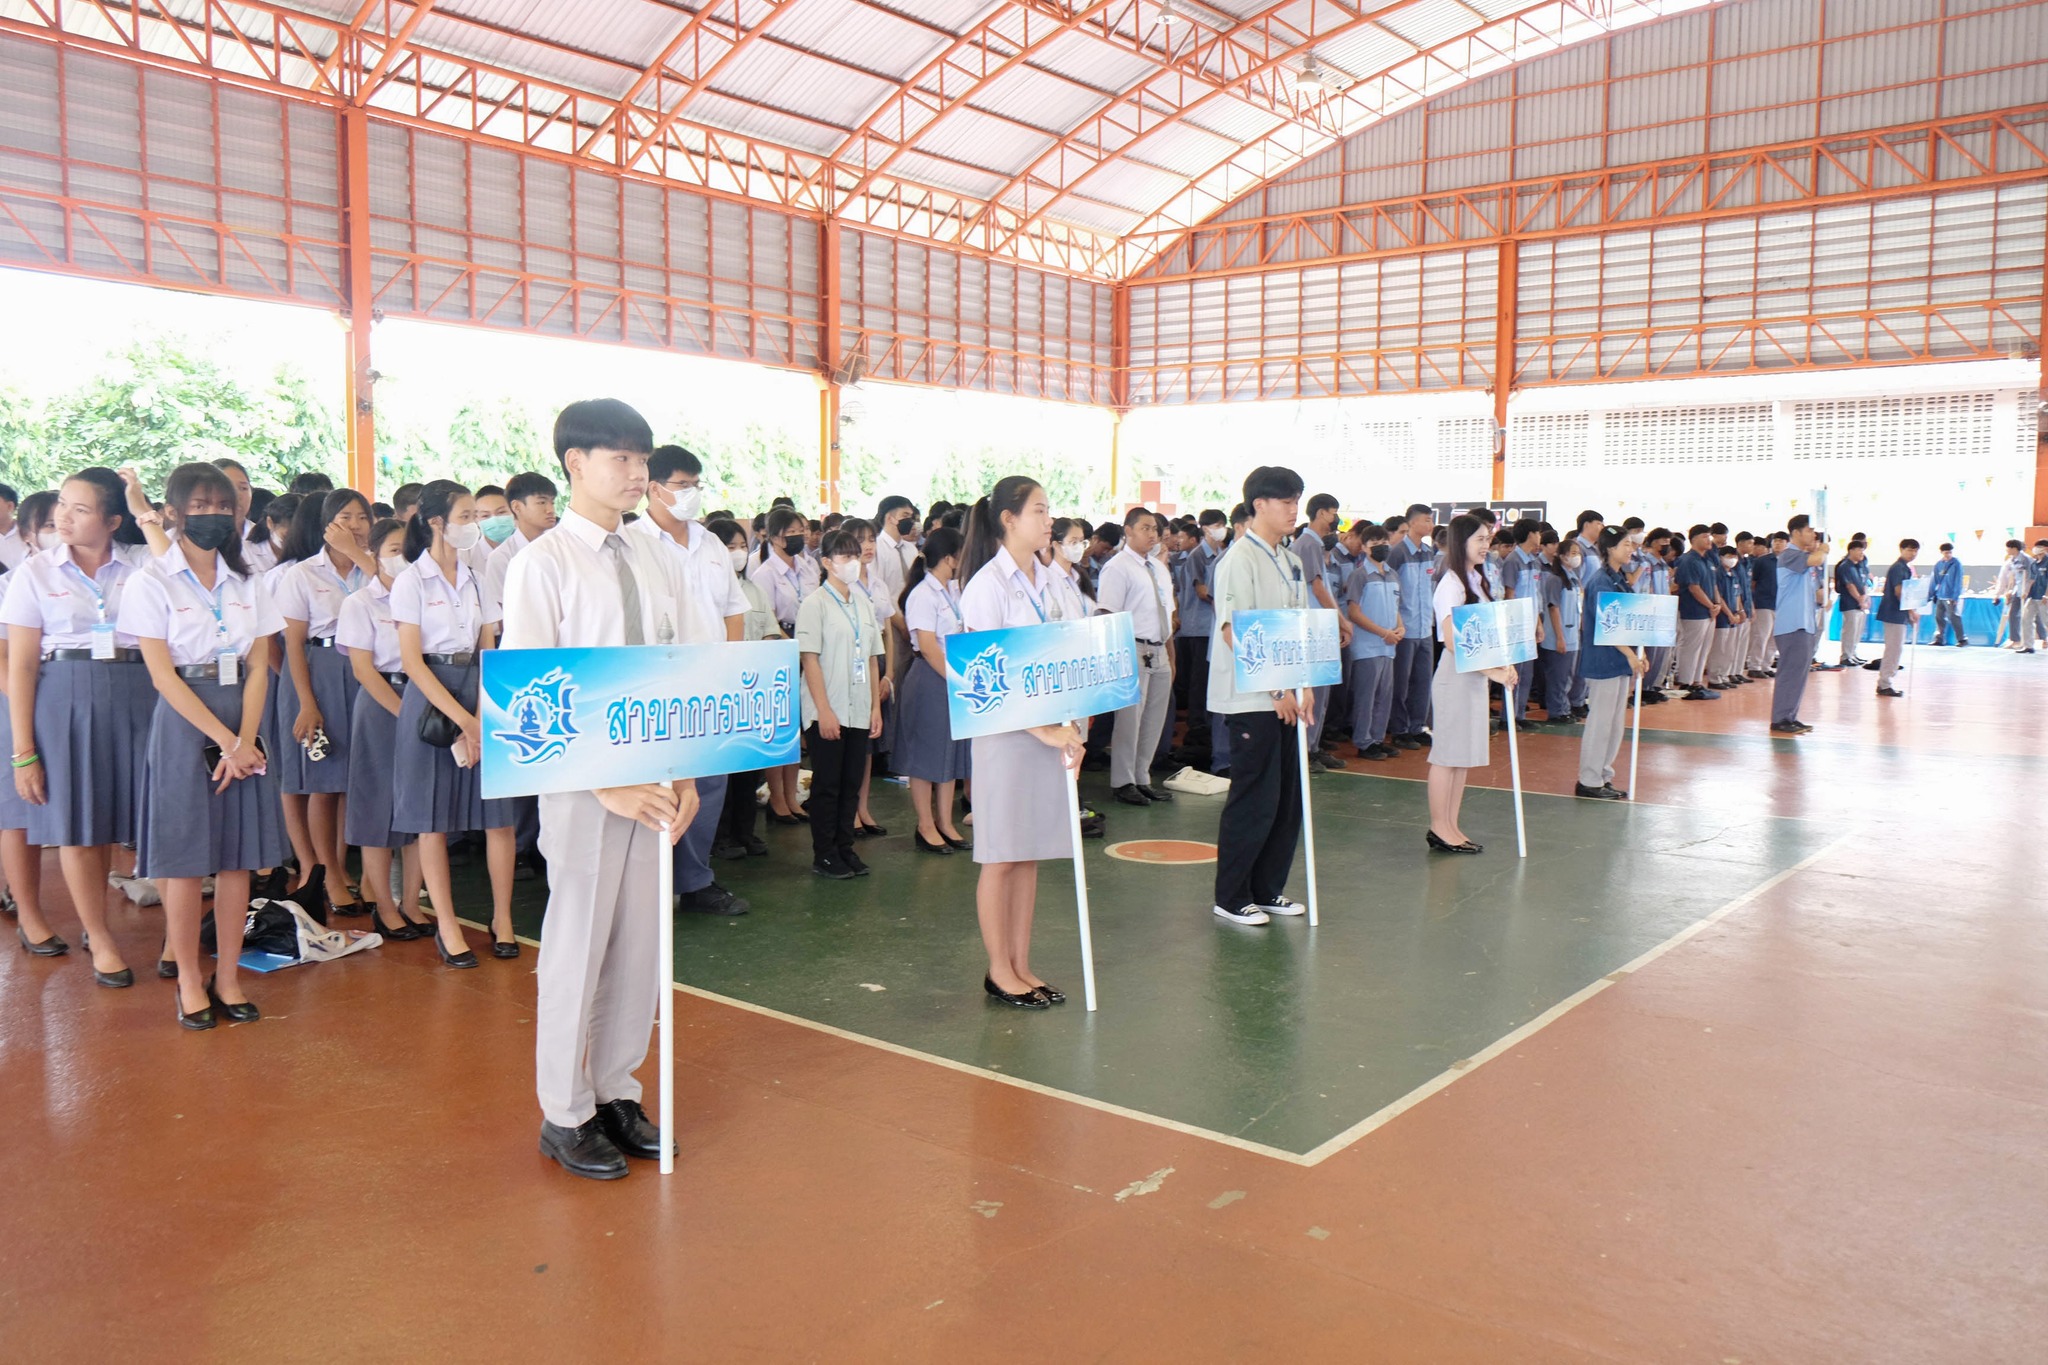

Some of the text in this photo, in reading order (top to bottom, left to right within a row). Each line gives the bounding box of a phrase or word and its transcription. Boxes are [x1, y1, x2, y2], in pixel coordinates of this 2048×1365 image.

[606, 665, 790, 744] สาขาการบัญชี
